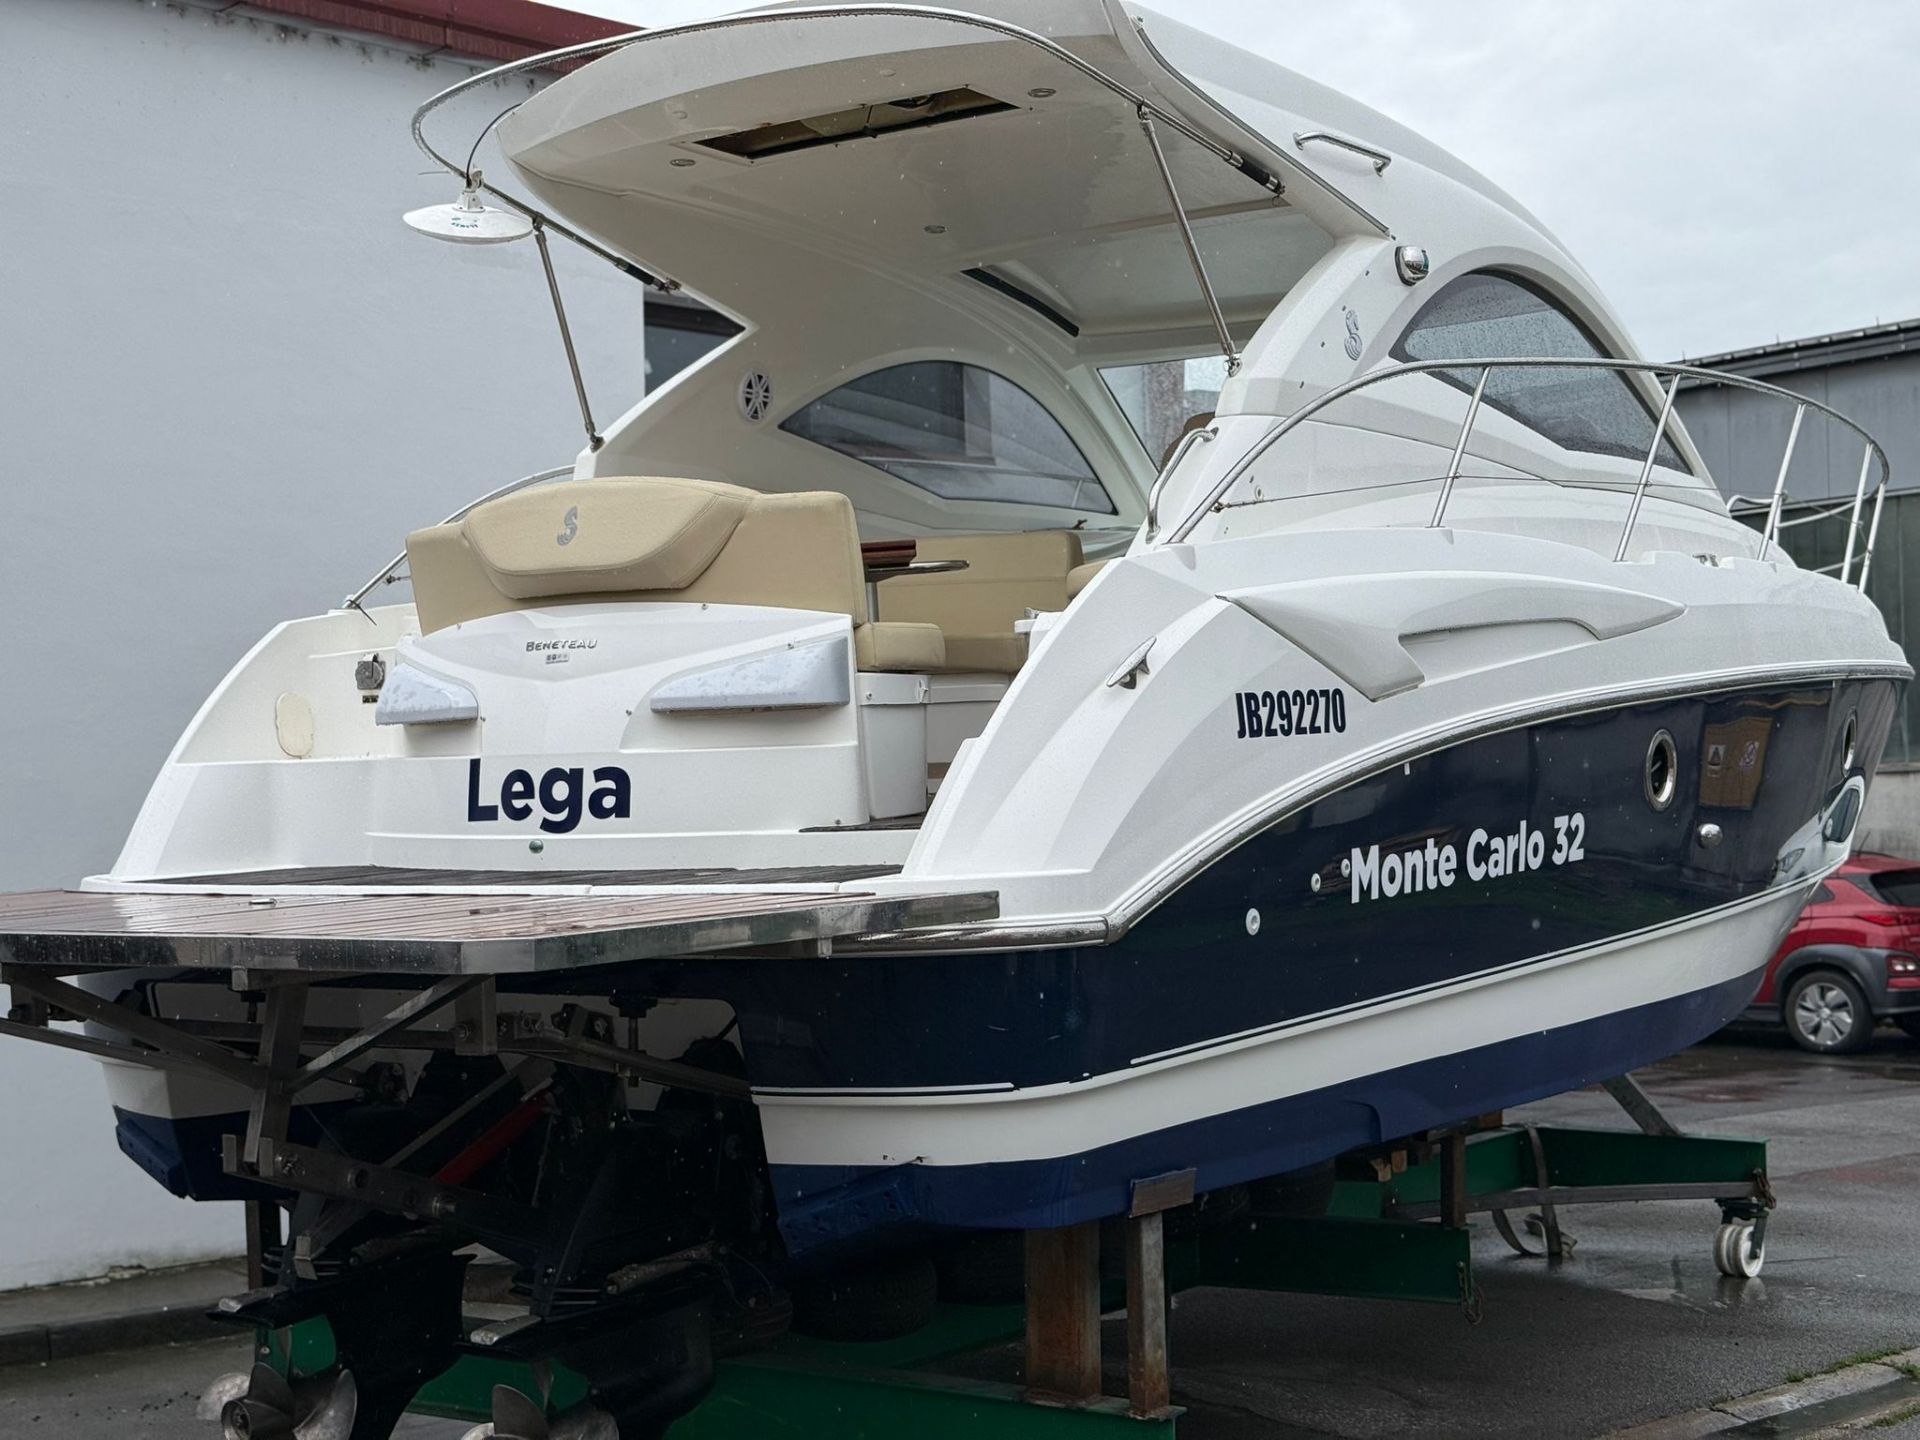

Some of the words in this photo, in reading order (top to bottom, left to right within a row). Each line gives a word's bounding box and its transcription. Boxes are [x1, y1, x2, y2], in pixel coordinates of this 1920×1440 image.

[1235, 688, 1346, 739] JB292270
[468, 758, 631, 834] Lega
[1351, 838, 1457, 904] Monte
[1466, 820, 1545, 882] Carlo
[1552, 812, 1585, 865] 32
